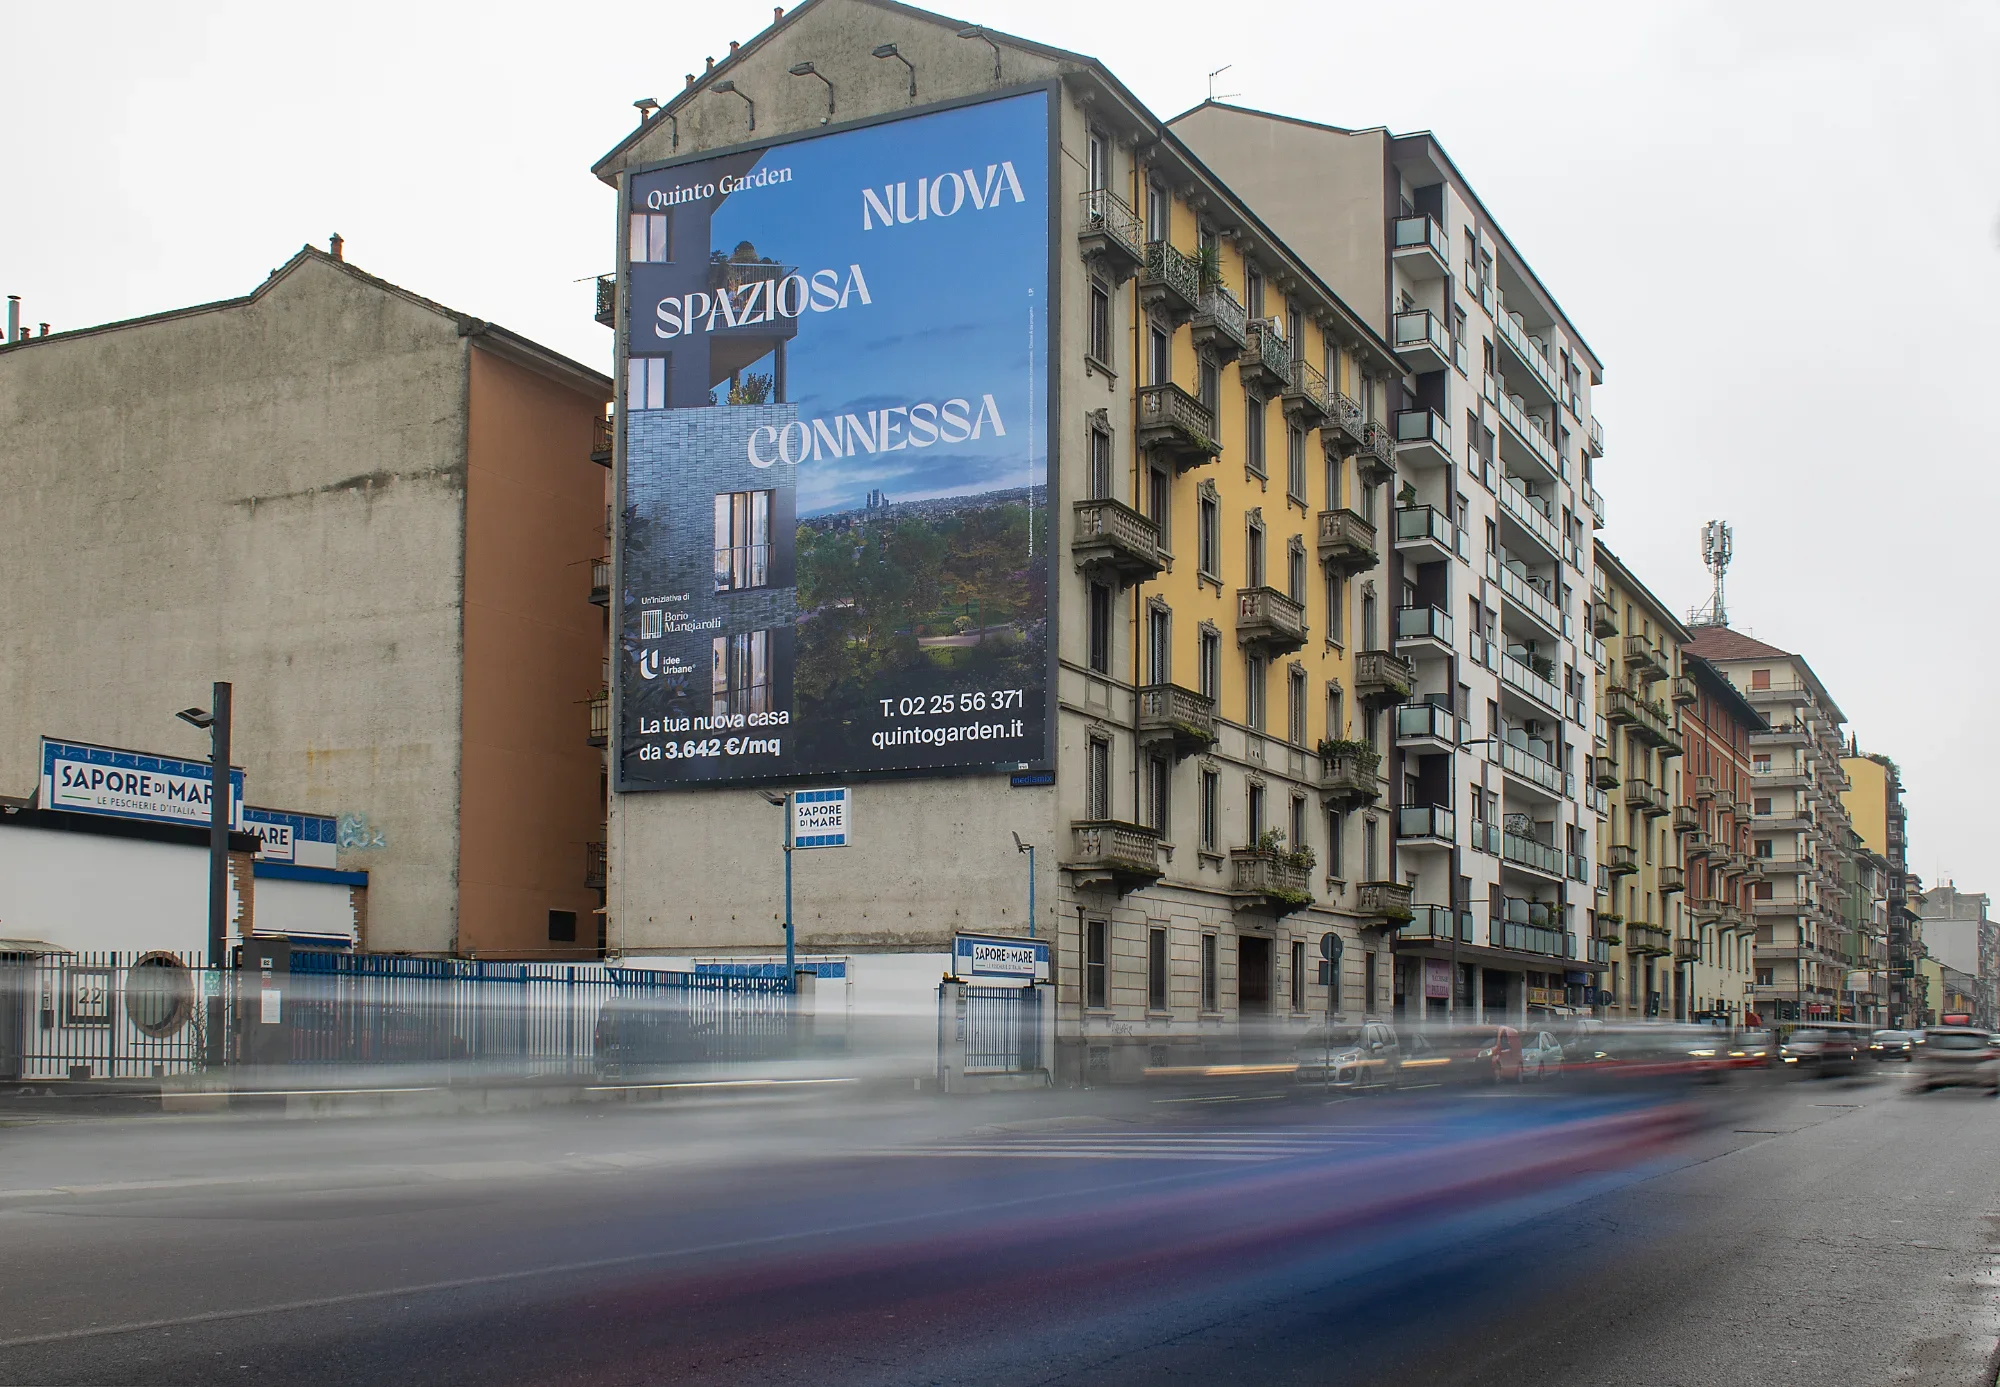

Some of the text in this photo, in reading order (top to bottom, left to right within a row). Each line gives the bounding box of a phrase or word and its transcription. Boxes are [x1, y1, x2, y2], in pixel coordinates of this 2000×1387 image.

[647, 167, 793, 210] Quinto Garden
[862, 161, 1025, 230] NUOVA
[655, 264, 872, 338] SPAZIOSA
[748, 394, 1006, 468] CONNESSA
[664, 611, 689, 621] Borio
[664, 617, 721, 633] Mangiarotti
[663, 656, 680, 665] idee
[880, 689, 1023, 717] T. 02 25 56 371
[640, 710, 789, 734] La tua nuova casa
[872, 719, 1024, 750] quintogarden.it
[639, 736, 781, 761] da 3.642 €/mq
[62, 765, 213, 804] SAPORE DI MAR
[1012, 775, 1052, 784] mediamix
[97, 797, 196, 816] LE PESCHERIE D'ITALIA
[799, 804, 842, 817] SAPORE
[810, 816, 842, 827] MARE
[975, 947, 1006, 961] SAPORE
[1012, 951, 1033, 963] MARE
[79, 987, 101, 1004] 22
